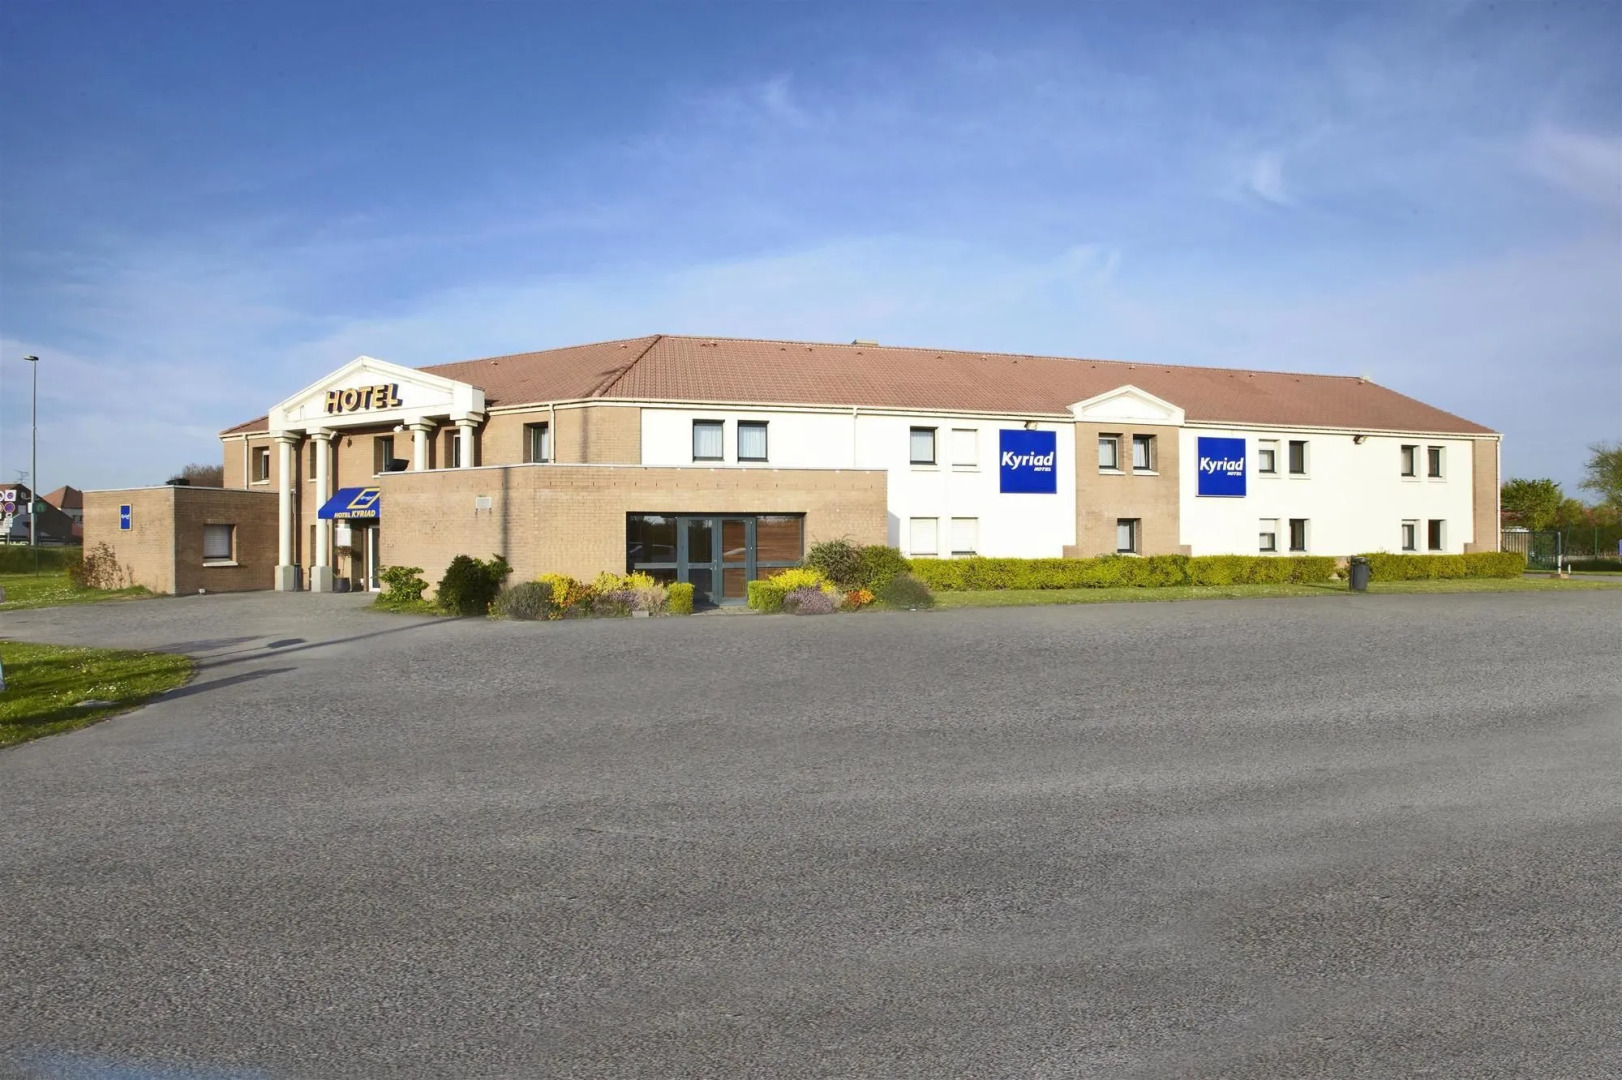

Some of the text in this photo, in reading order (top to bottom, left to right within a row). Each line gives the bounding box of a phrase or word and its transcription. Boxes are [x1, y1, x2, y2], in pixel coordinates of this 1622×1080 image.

[325, 383, 402, 413] HOTEL
[1001, 451, 1054, 470] Kyriad
[1200, 457, 1244, 474] Kyriad
